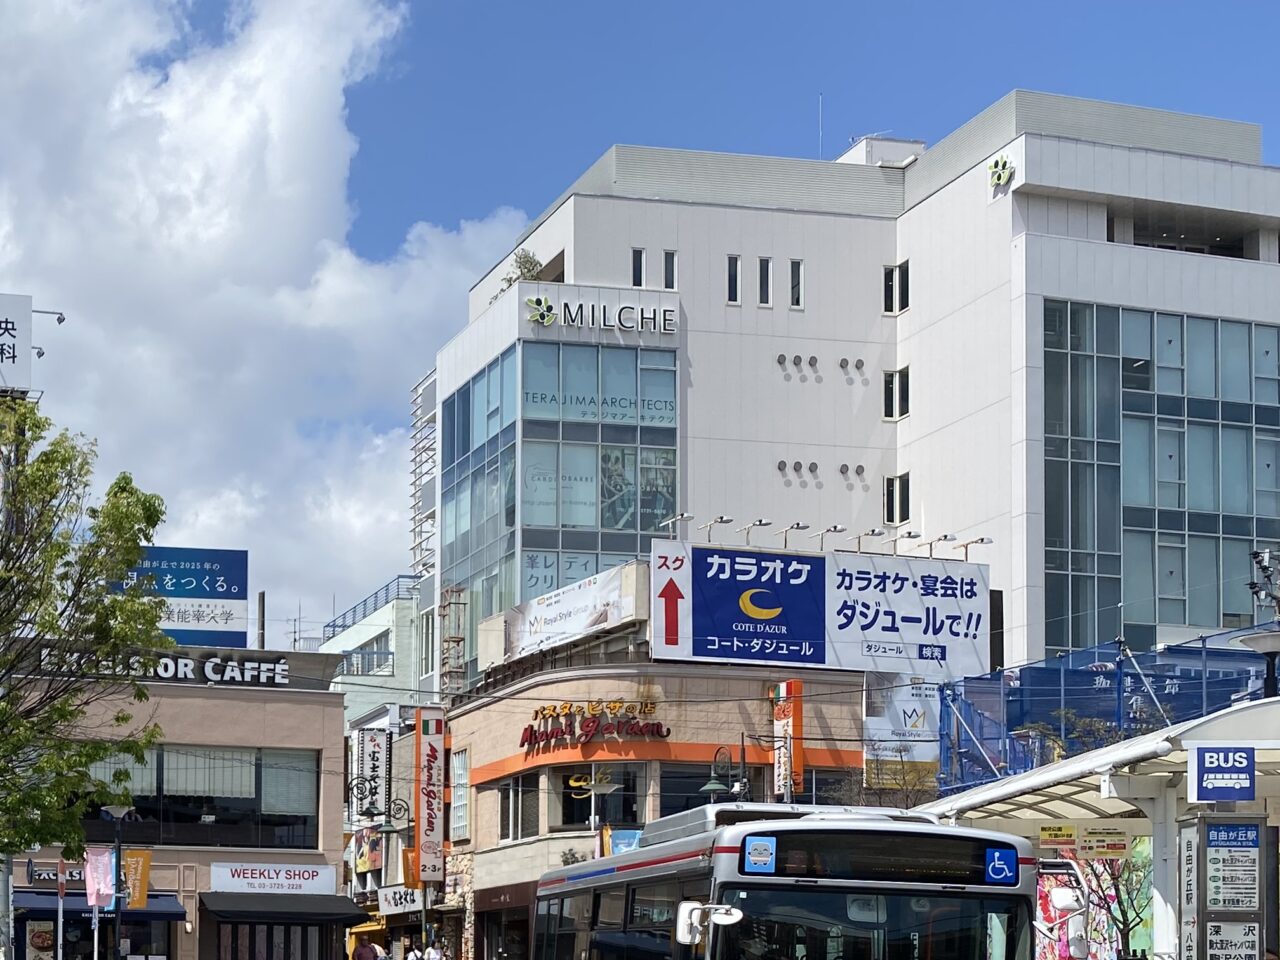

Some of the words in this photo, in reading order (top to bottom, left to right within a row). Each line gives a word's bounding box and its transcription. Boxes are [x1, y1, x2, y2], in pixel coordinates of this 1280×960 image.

[561, 300, 676, 333] MILCHE
[525, 392, 597, 406] TERAJIMA
[601, 397, 675, 412] ARCHTECTS
[657, 555, 686, 571] スグ
[706, 555, 811, 585] カラオケ
[836, 568, 978, 599] カラオケ・宴会は
[757, 623, 788, 635] D'AZUR
[706, 636, 814, 656] コート・ダジュール
[865, 643, 904, 656] ダジュール
[204, 657, 290, 684] CAFFÉ
[532, 700, 658, 720] パスタとピザの店
[1204, 752, 1248, 768] BUS
[1209, 830, 1257, 841] 自由が丘駅
[230, 868, 282, 880] WEEKLY
[284, 869, 319, 881] SHOP
